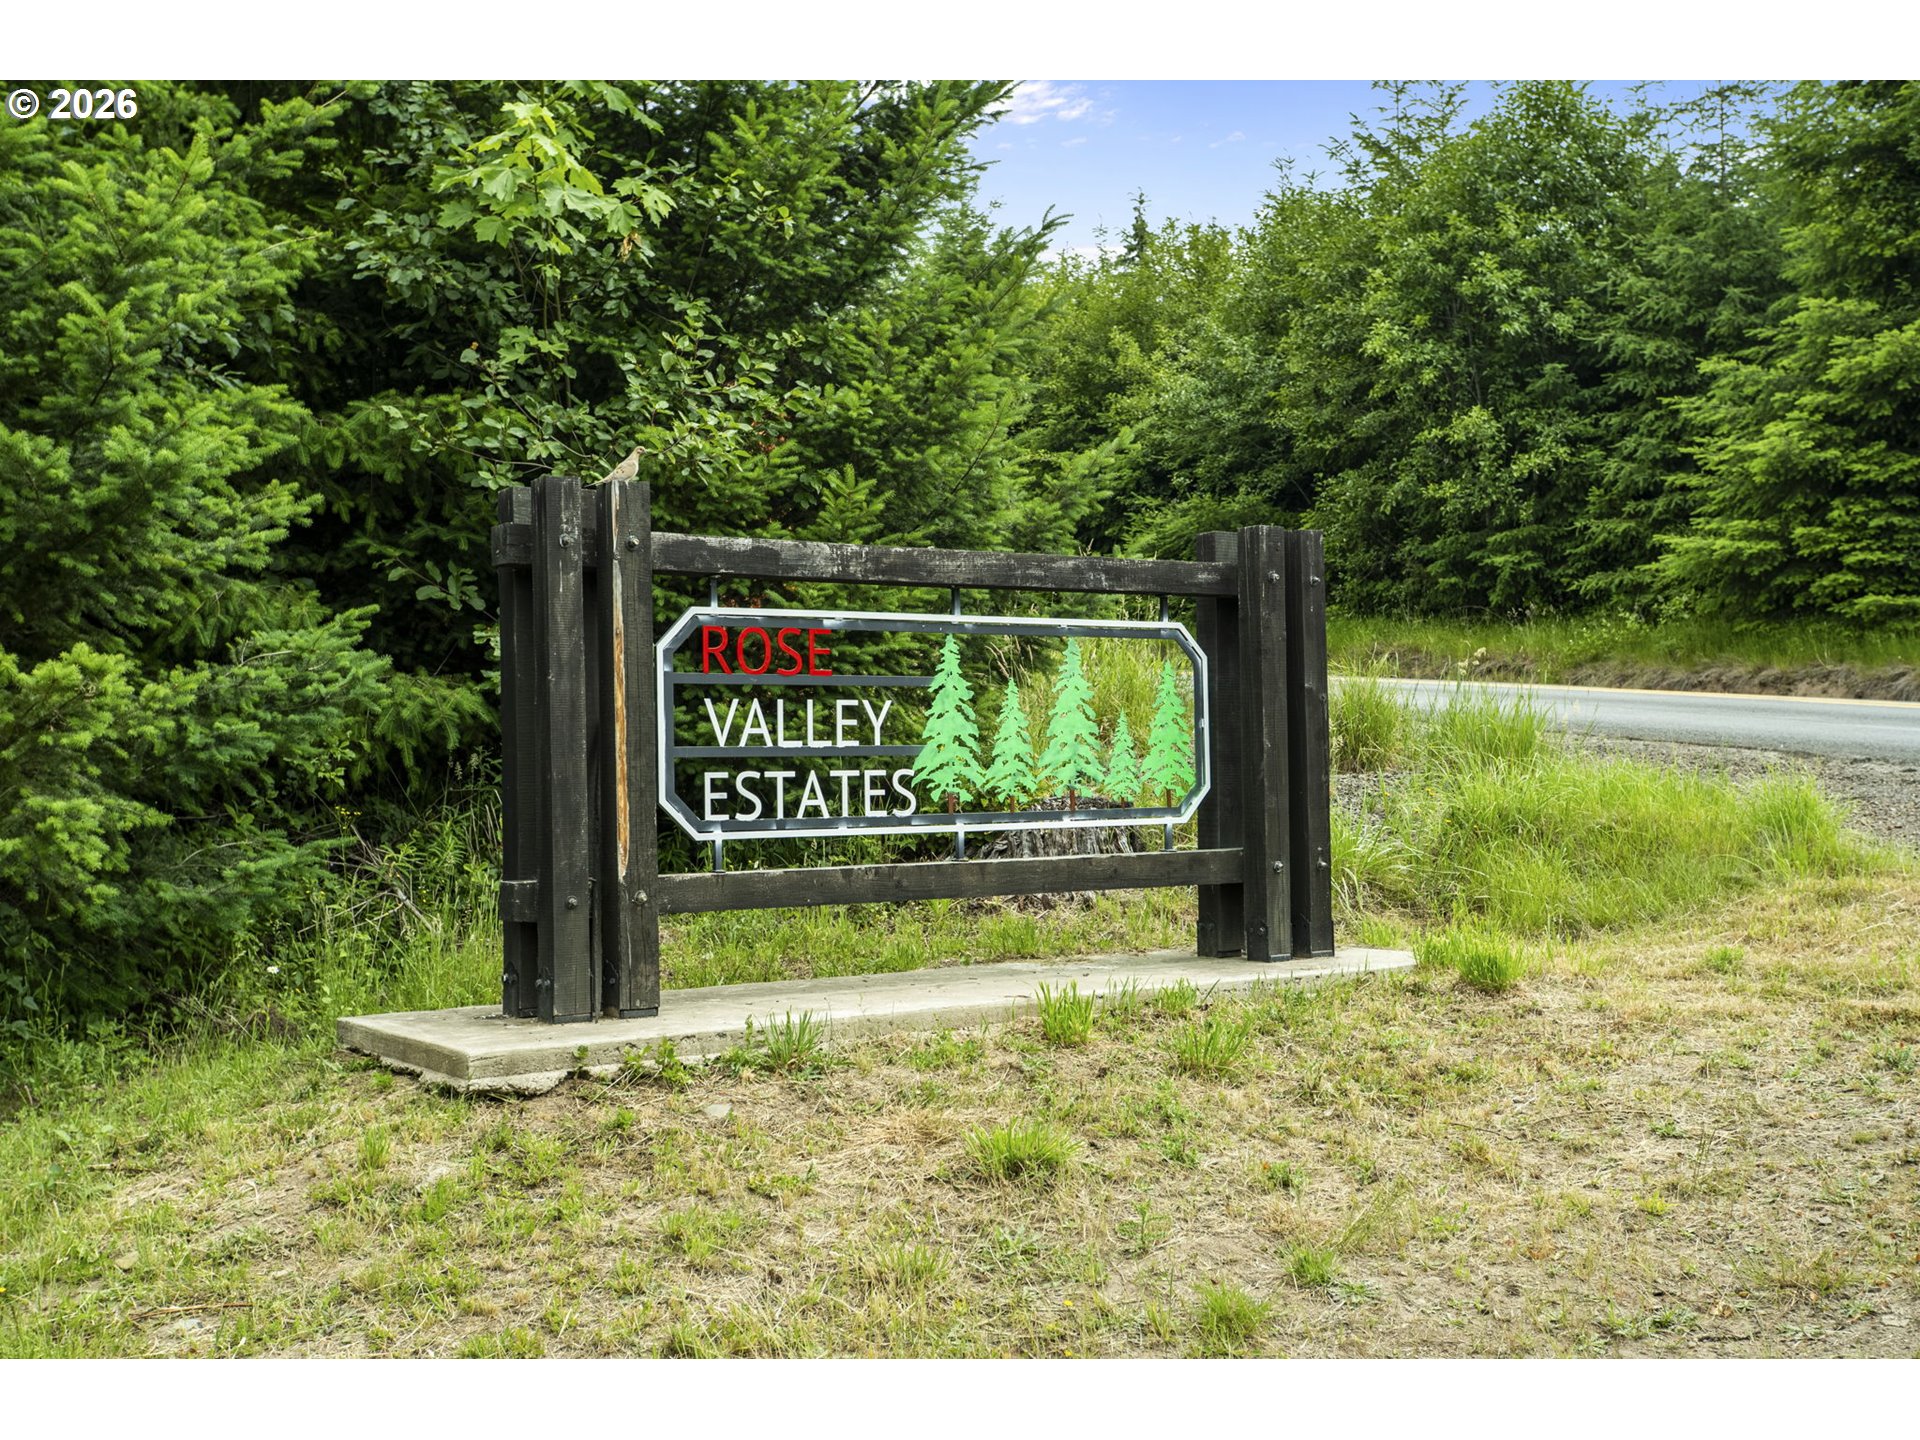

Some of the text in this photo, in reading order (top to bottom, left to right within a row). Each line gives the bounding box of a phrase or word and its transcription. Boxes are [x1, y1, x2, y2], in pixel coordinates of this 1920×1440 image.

[702, 625, 833, 677] ROSE
[703, 697, 893, 748] VALLEY
[703, 768, 917, 822] ESTATES
